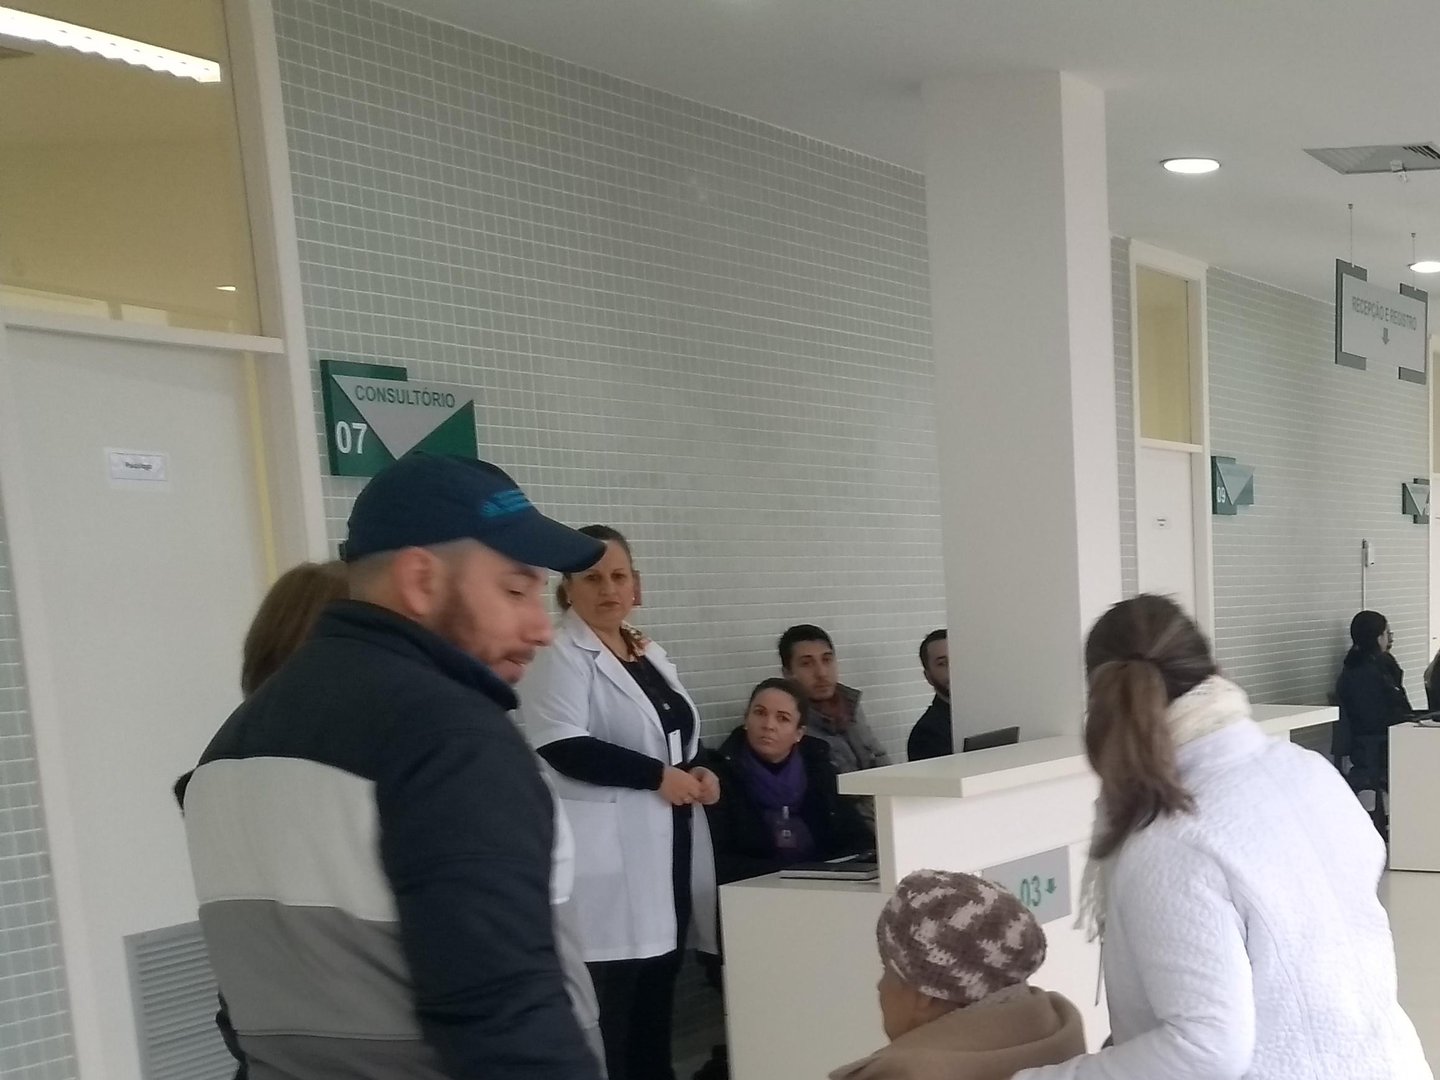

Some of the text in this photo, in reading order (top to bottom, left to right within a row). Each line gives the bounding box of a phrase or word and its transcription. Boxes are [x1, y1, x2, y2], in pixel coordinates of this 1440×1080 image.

[355, 385, 455, 408] CONSULTÓRIO
[336, 421, 367, 454] 07
[1021, 875, 1041, 907] 03
